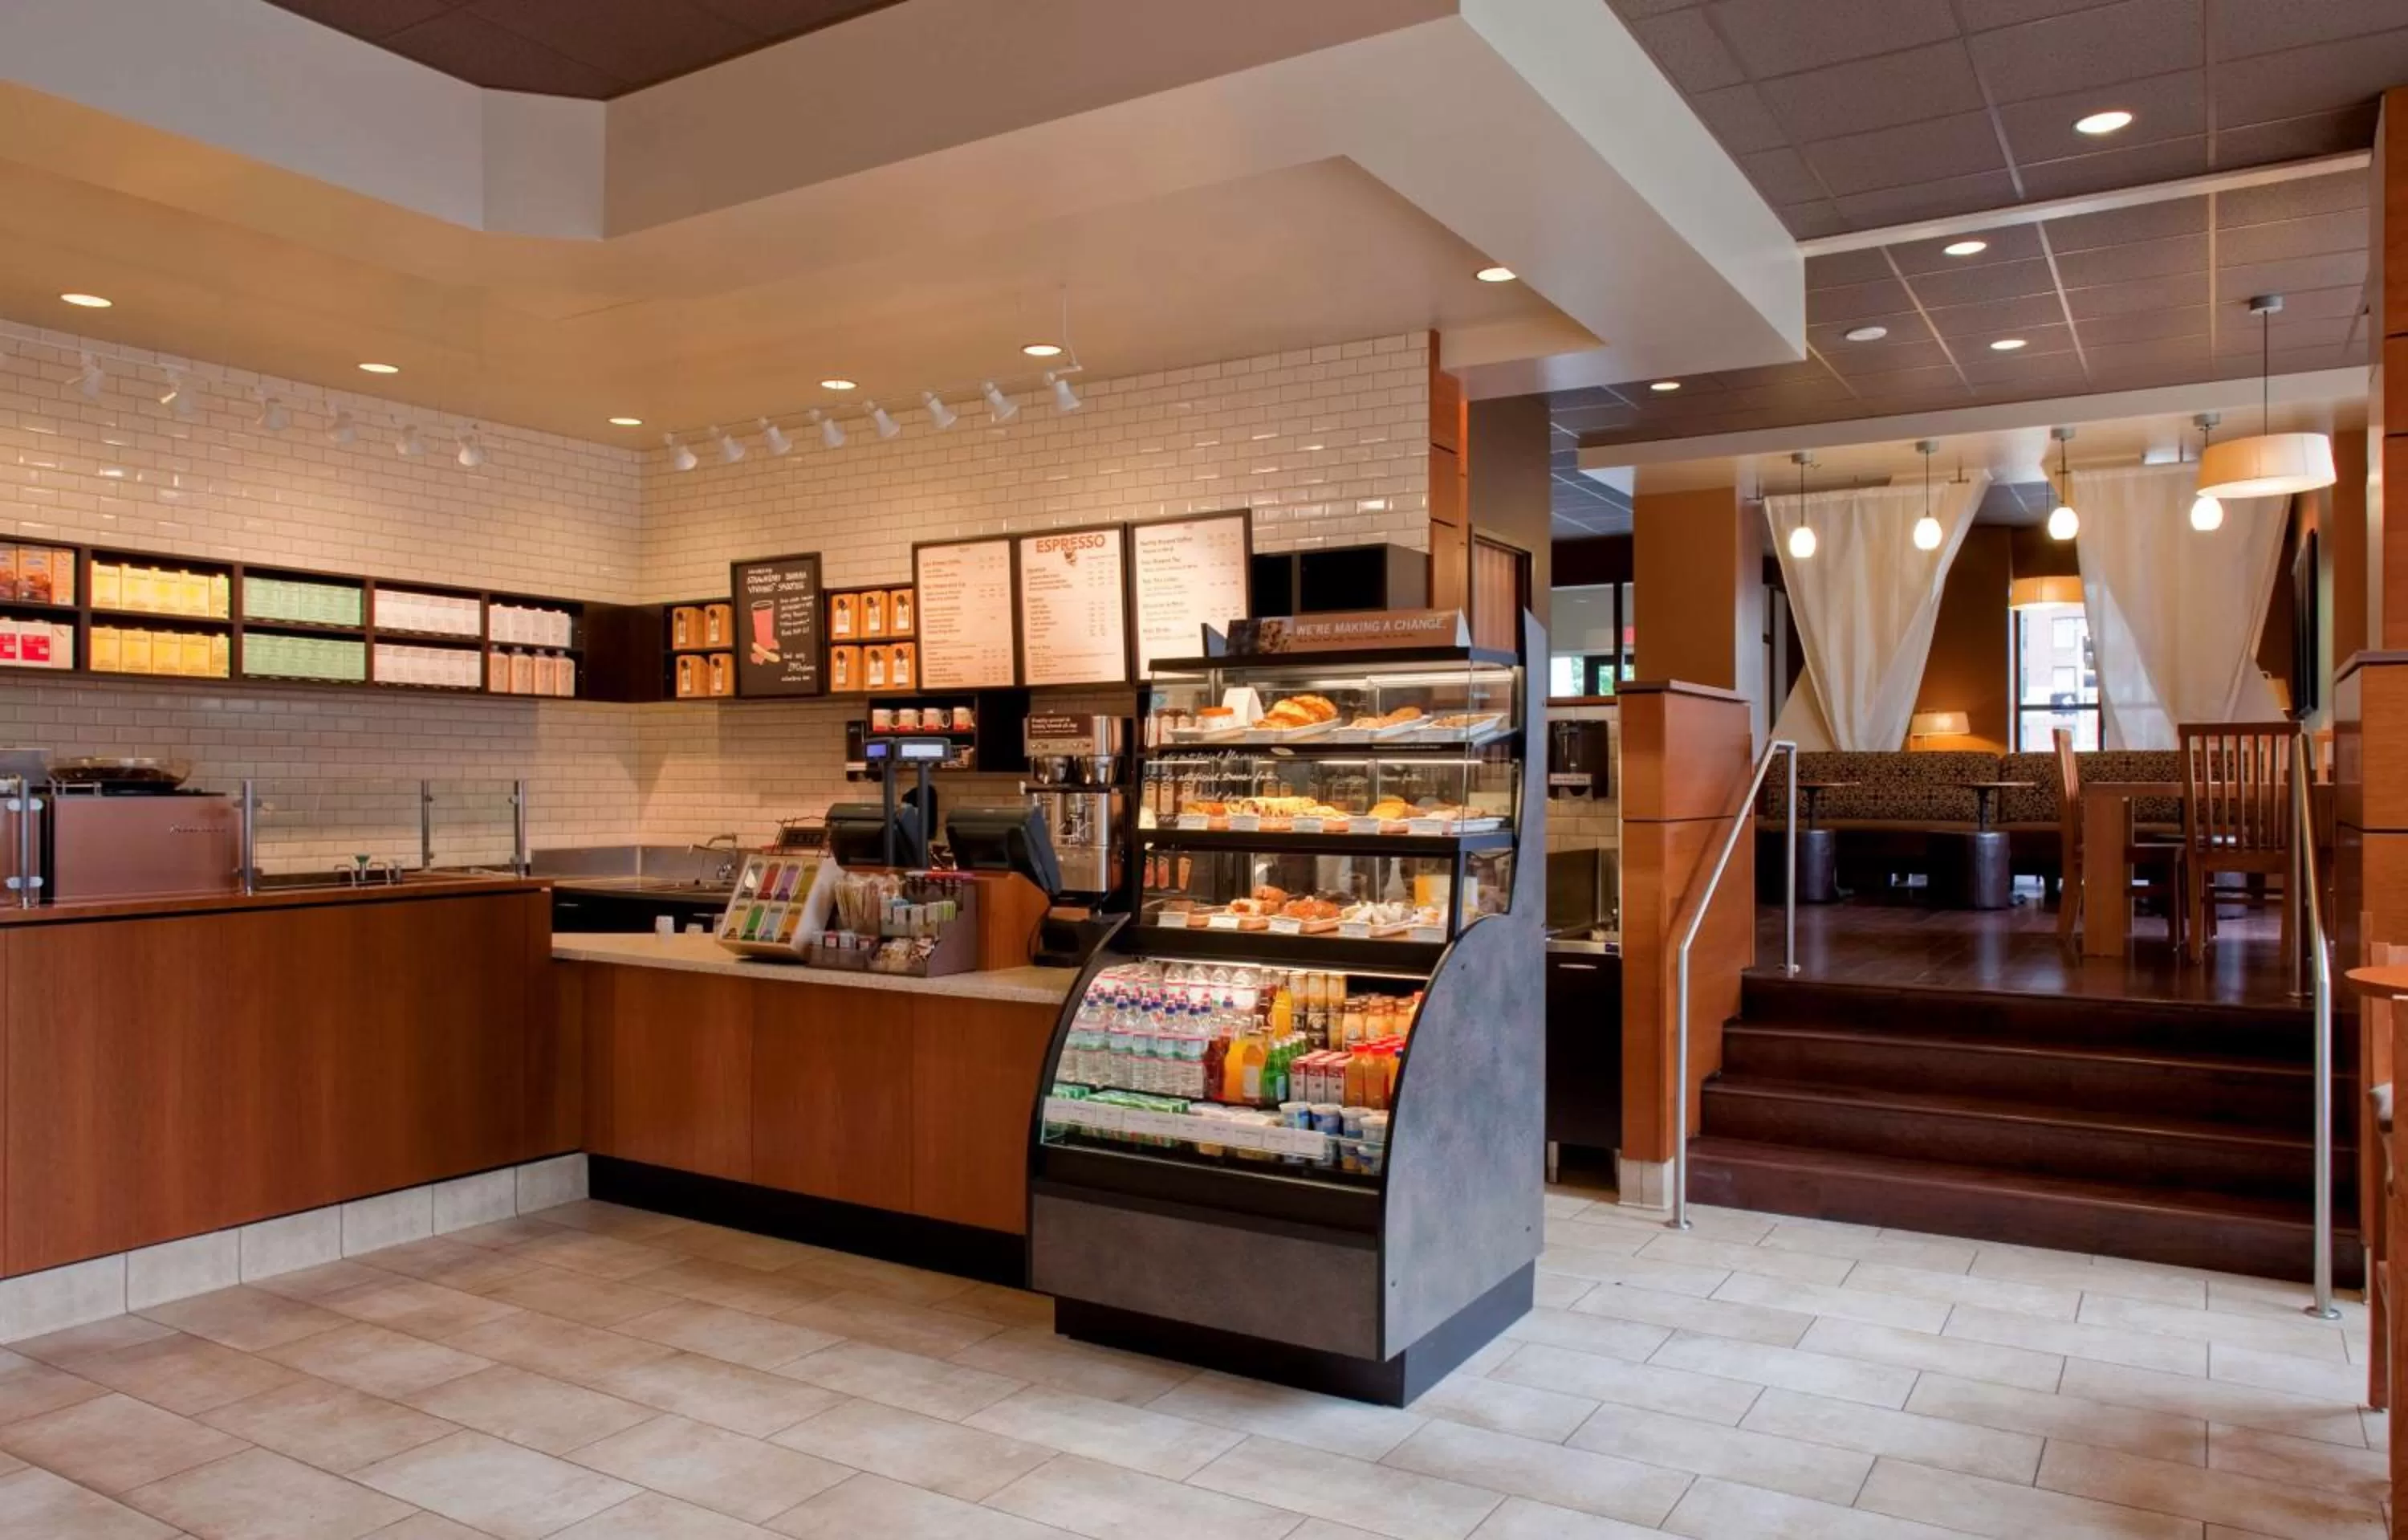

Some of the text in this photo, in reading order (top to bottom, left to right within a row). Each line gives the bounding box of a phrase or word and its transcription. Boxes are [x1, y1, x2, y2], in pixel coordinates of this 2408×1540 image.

[1036, 534, 1105, 553] ESPRESSO
[1335, 621, 1380, 634] MAKING
[1383, 621, 1391, 630] A
